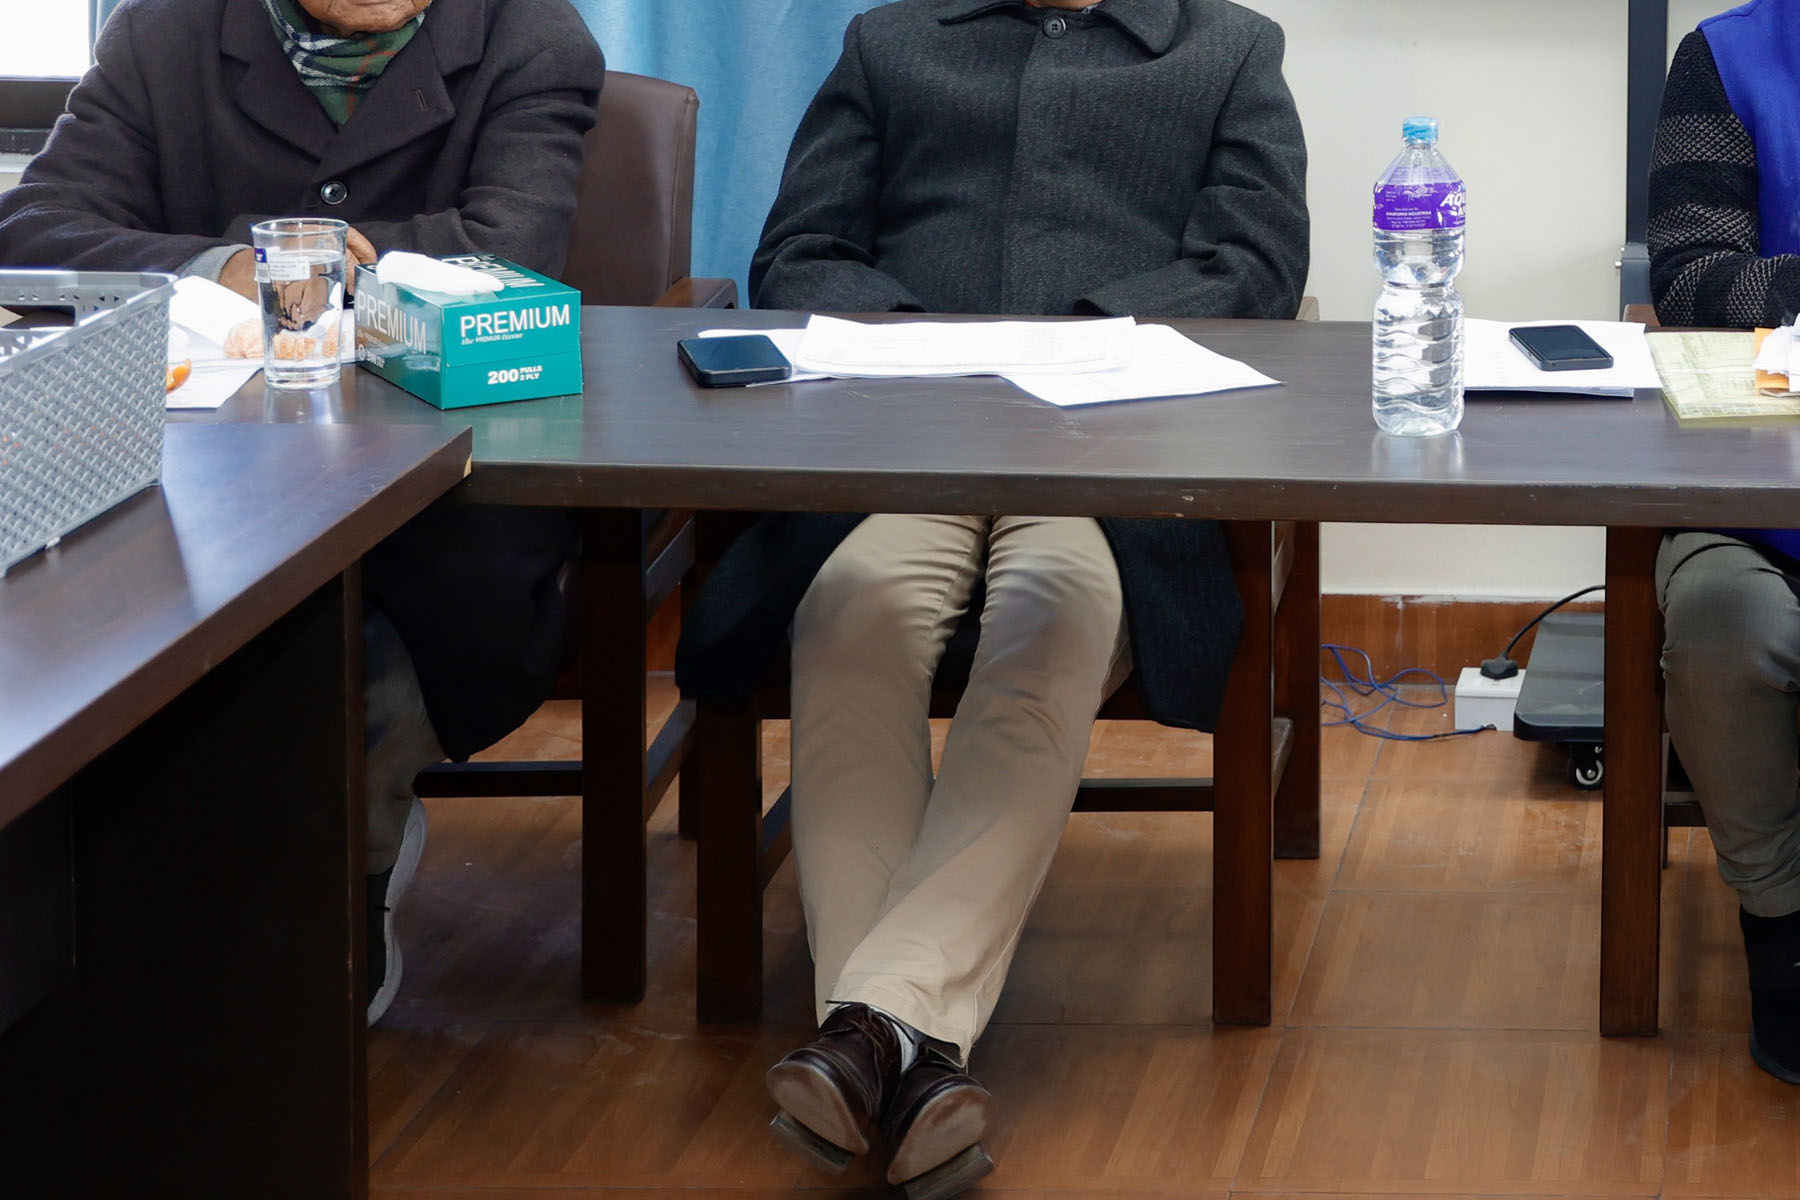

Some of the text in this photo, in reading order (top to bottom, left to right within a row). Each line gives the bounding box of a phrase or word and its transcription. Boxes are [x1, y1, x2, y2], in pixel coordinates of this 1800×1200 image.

[357, 290, 427, 354] PREMIUM
[460, 303, 570, 338] PREMIUM
[487, 368, 519, 385] 200
